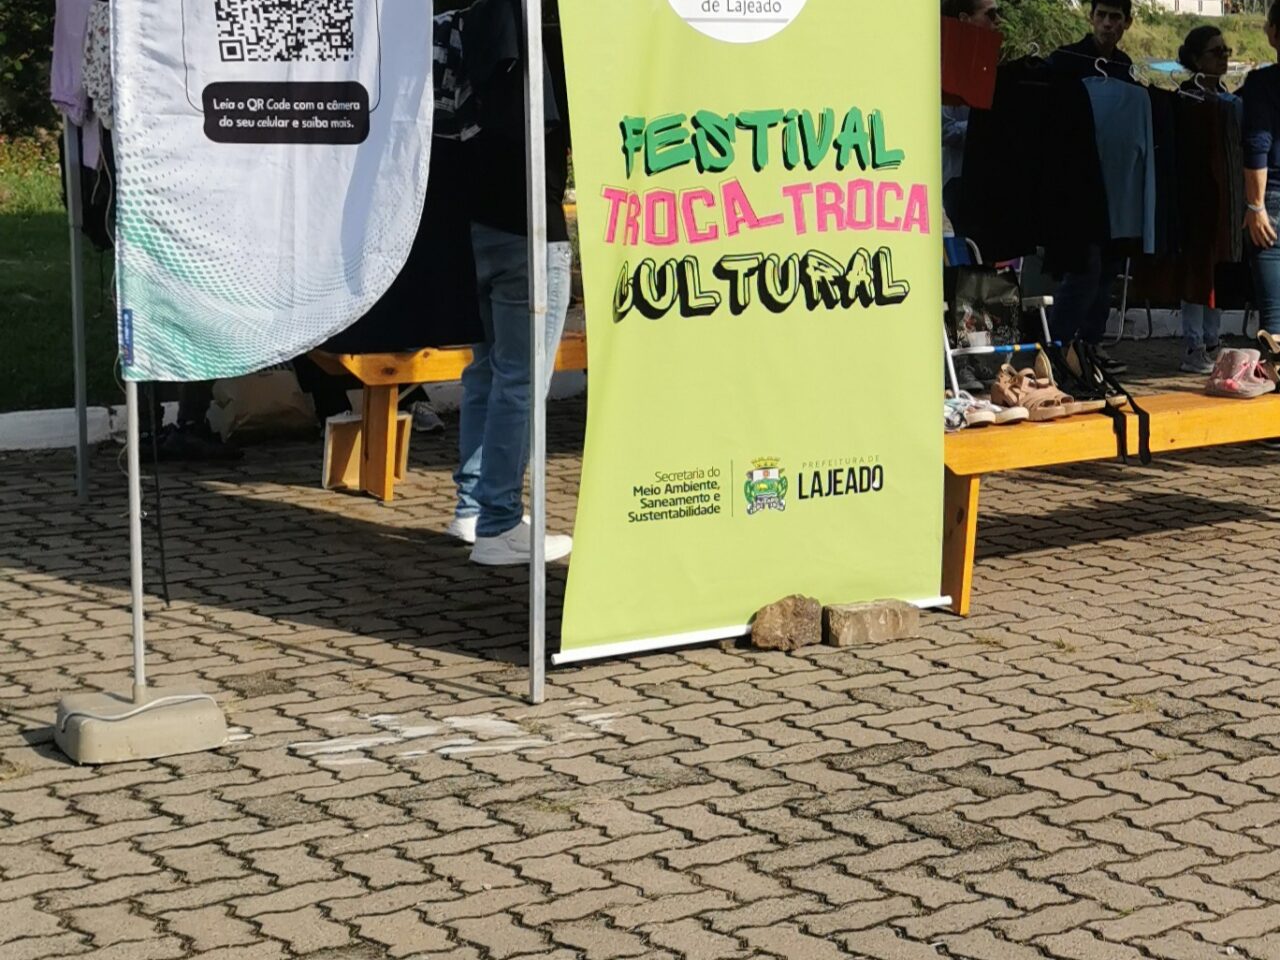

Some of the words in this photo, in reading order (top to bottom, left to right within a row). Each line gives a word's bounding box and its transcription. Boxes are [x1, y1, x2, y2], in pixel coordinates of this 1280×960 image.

[212, 98, 236, 111] Leia
[237, 101, 245, 110] o
[246, 98, 265, 112] QR
[266, 98, 291, 110] Code
[293, 101, 315, 111] com
[316, 101, 324, 110] a
[326, 100, 361, 111] câmera
[218, 115, 234, 128] do
[236, 118, 255, 128] seu
[256, 115, 290, 129] celular
[292, 119, 300, 129] e
[301, 115, 329, 129] saiba
[330, 116, 355, 129] mais.
[620, 105, 906, 180] FESTIVAL
[802, 455, 865, 469] PREFEITURA
[867, 454, 880, 463] DE
[654, 467, 705, 483] Secretaria
[707, 466, 721, 478] do
[798, 464, 884, 500] LAJEADO
[633, 484, 661, 497] Meio
[664, 480, 721, 495] Ambiente,
[640, 493, 711, 510] Saneamento
[713, 493, 721, 501] e
[627, 503, 721, 523] Sustentabilidade
